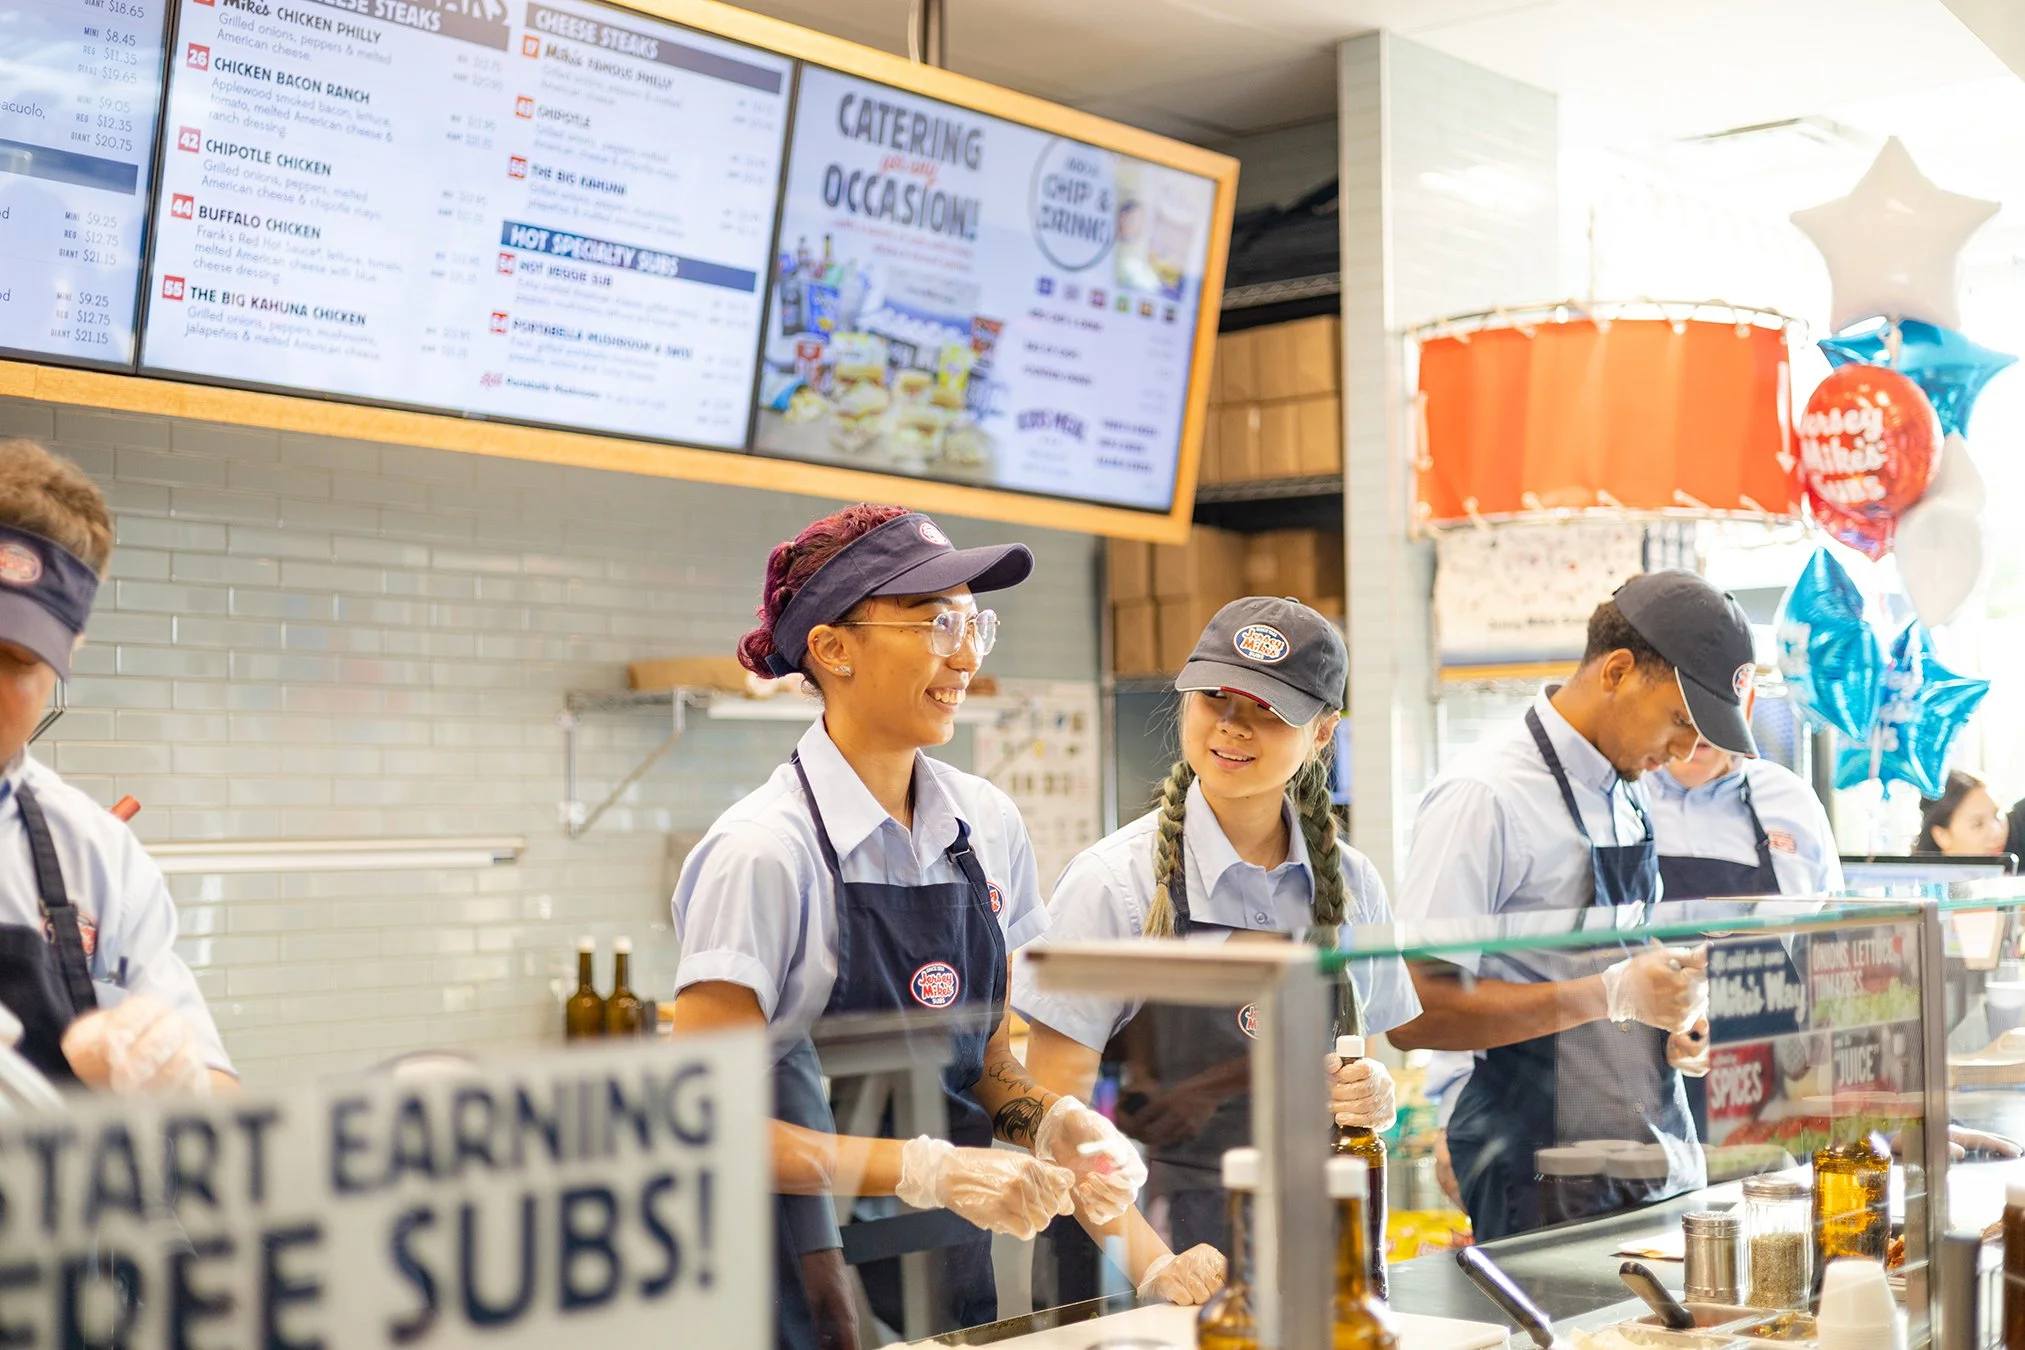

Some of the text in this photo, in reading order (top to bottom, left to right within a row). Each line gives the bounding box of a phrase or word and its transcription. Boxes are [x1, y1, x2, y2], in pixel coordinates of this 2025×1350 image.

[109, 0, 144, 18] $18.65
[375, 0, 442, 32] STEAKS
[277, 7, 332, 32] CHICKEN
[337, 22, 382, 45] PHILLY
[534, 9, 598, 44] CHEESE
[600, 26, 660, 60] STEAKS
[84, 27, 136, 47] MINI $8.45
[217, 29, 268, 50] American
[219, 12, 255, 31] Grilled
[258, 25, 297, 42] onions,
[301, 34, 342, 53] peppers
[357, 49, 392, 66] melted
[82, 45, 137, 65] REG $11.35
[189, 51, 208, 66] 26
[78, 63, 137, 84] GIANT $19.65
[214, 57, 371, 105] CHICKEN BACON RANCH
[99, 96, 131, 114] $9.05
[212, 77, 273, 101] Applewood
[276, 92, 315, 111] smoked
[319, 102, 353, 119] bacon,
[0, 101, 45, 119] acuolo,
[208, 109, 240, 126] ranch
[211, 93, 251, 112] tomato,
[254, 103, 291, 121] melted
[294, 111, 342, 132] American
[346, 123, 384, 140] cheese
[76, 113, 132, 132] REG $12.35
[838, 93, 983, 170] CATERING
[71, 131, 132, 151] GIANT $20.75
[180, 132, 198, 149] 42
[205, 139, 332, 177] CHIPOTLE CHICKEN
[201, 175, 253, 195] American
[257, 184, 295, 202] cheese
[203, 158, 239, 177] Grilled
[243, 168, 282, 187] onions,
[334, 186, 369, 203] melted
[173, 200, 192, 216] 44
[824, 164, 982, 241] OCCASION!
[65, 211, 117, 228] MINI $9.25
[199, 206, 321, 239] BUFFALO CHICKEN
[64, 230, 119, 247] REG $12.75
[197, 226, 234, 243] Frank's
[238, 233, 259, 246] Red
[58, 248, 117, 266] GIANT $21.15
[194, 243, 231, 258] melted
[236, 249, 285, 268] American
[289, 259, 326, 273] cheese
[510, 225, 680, 278] HOT SPECIALTY SUBS
[193, 258, 232, 273] cheese
[56, 292, 109, 307] MINI $9.25
[190, 286, 366, 327] THE BIG KAHUNA CHICKEN
[56, 310, 111, 326] REG $12.75
[187, 306, 223, 321] Grilled
[227, 315, 266, 330] onions,
[50, 328, 109, 345] GIANT $21.15
[255, 335, 290, 349] melted
[1801, 407, 1884, 442] ersey
[1240, 639, 1281, 658] Mike's
[1242, 628, 1284, 651] Jersey
[1813, 942, 1849, 970] ONIONS
[918, 971, 954, 986] Jersey
[922, 984, 954, 1000] Mike's
[1710, 1061, 1763, 1109] SPICES
[327, 1064, 716, 1198] EARNING
[388, 1170, 714, 1345] SUBS!
